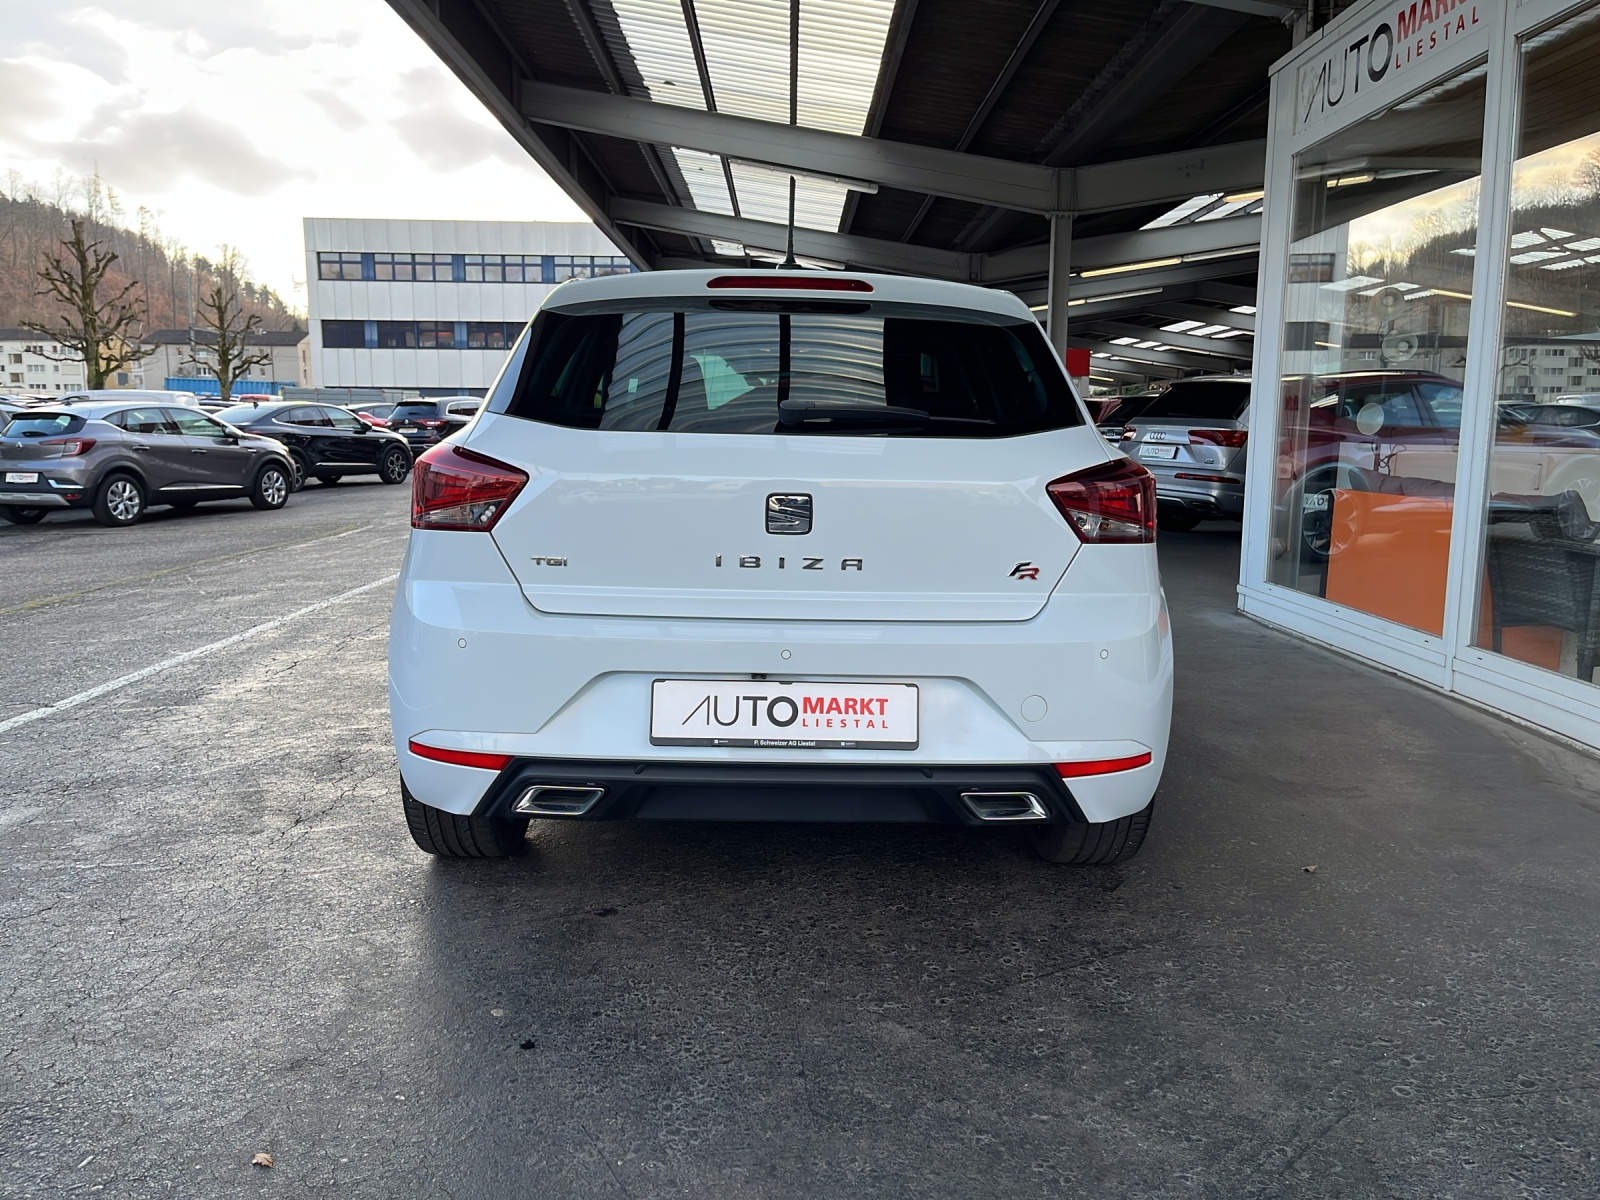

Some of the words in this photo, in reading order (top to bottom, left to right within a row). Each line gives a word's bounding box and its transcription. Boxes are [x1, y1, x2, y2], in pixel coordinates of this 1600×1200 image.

[1395, 6, 1479, 69] LIESTAL
[1303, 22, 1394, 124] AUTO
[530, 556, 568, 567] TGI
[715, 554, 863, 571] IBIZA
[1006, 560, 1040, 580] FR
[681, 694, 799, 728] AUTO
[802, 696, 889, 716] MARKT
[802, 718, 889, 729] LIESTAL
